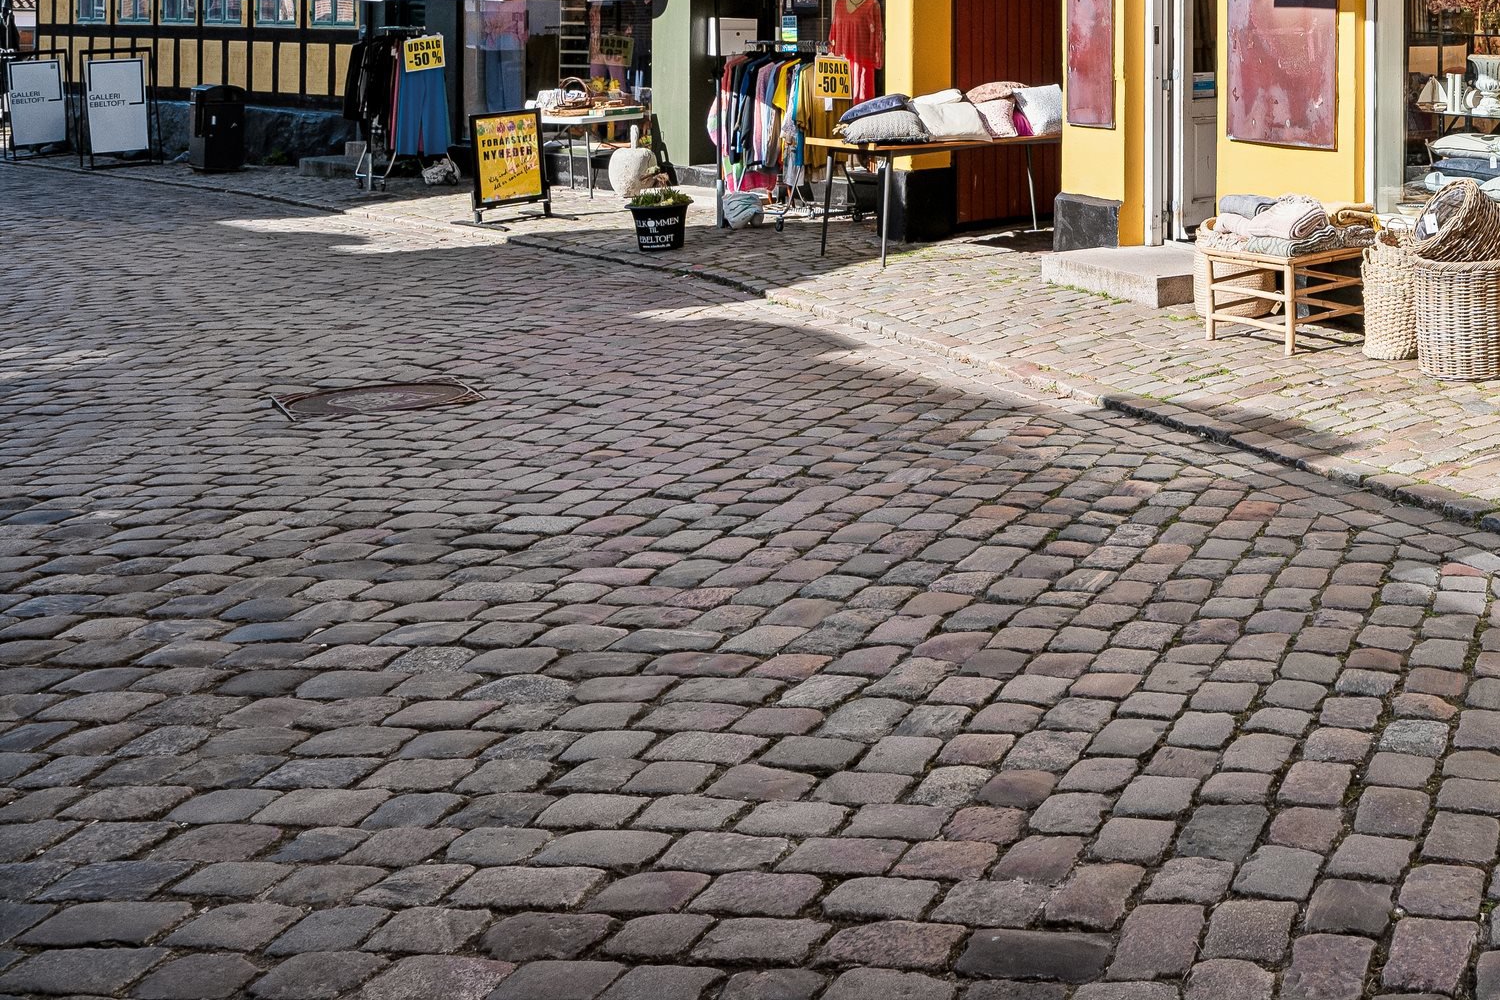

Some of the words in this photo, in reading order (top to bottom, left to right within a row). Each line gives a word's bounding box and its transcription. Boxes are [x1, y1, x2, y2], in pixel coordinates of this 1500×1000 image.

[407, 40, 441, 52] UDSALG
[409, 52, 430, 67] -50
[818, 61, 849, 75] UDSALG
[817, 76, 837, 94] -50
[11, 90, 41, 99] GALLERI
[88, 92, 121, 101] GALLERI
[11, 96, 46, 105] EBELTOFT
[89, 99, 126, 108] EBELTOFT
[483, 145, 532, 160] NYHEDER
[639, 233, 675, 244] EBELTOFT
